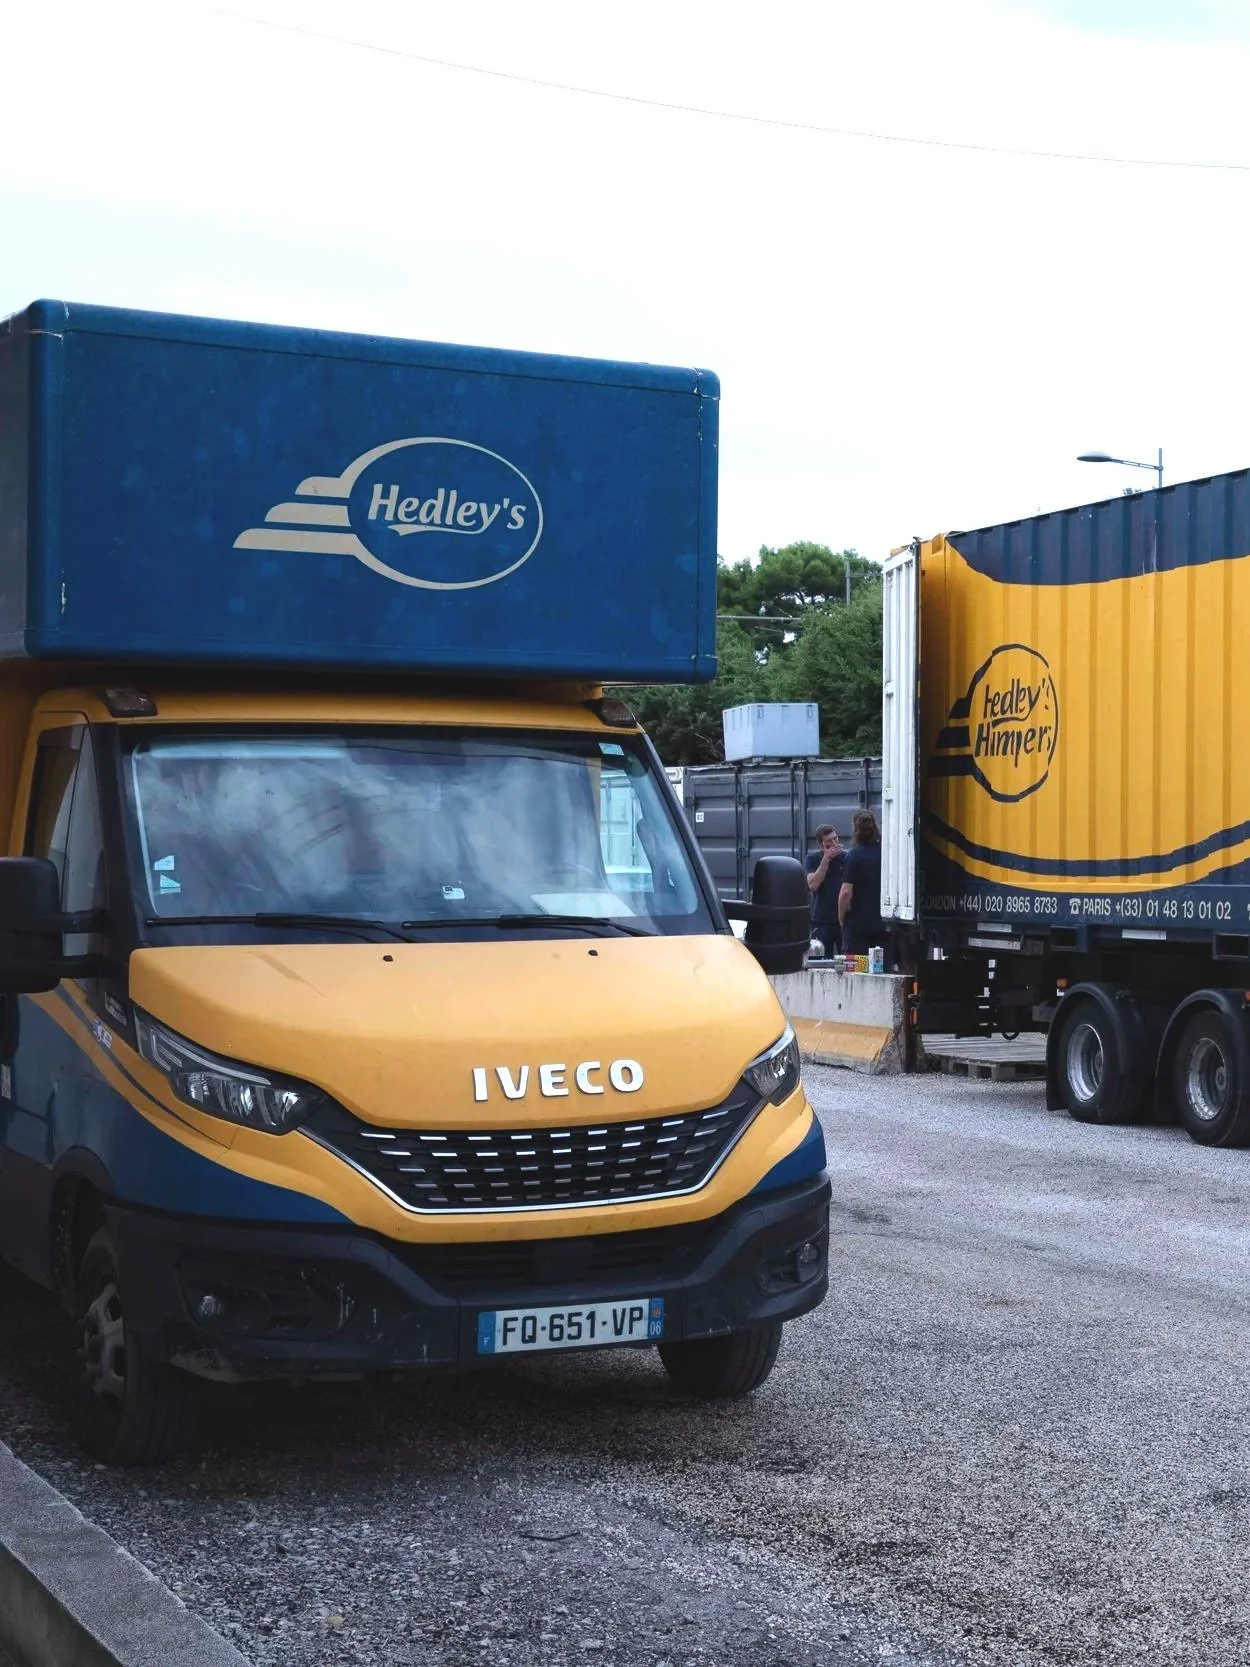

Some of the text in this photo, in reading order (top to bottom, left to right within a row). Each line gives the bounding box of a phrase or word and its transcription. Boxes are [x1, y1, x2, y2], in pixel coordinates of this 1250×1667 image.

[367, 483, 527, 536] Hedley's
[959, 894, 981, 913] +(44)
[985, 895, 1003, 913] 020
[1006, 896, 1031, 914] 8965
[1034, 896, 1058, 914] 8733
[1083, 898, 1231, 920] PARIS +(33) 01 48 13 01 02
[472, 1059, 644, 1102] IVECO
[502, 1306, 644, 1346] FQ-651-VP
[649, 1320, 662, 1336] 06
